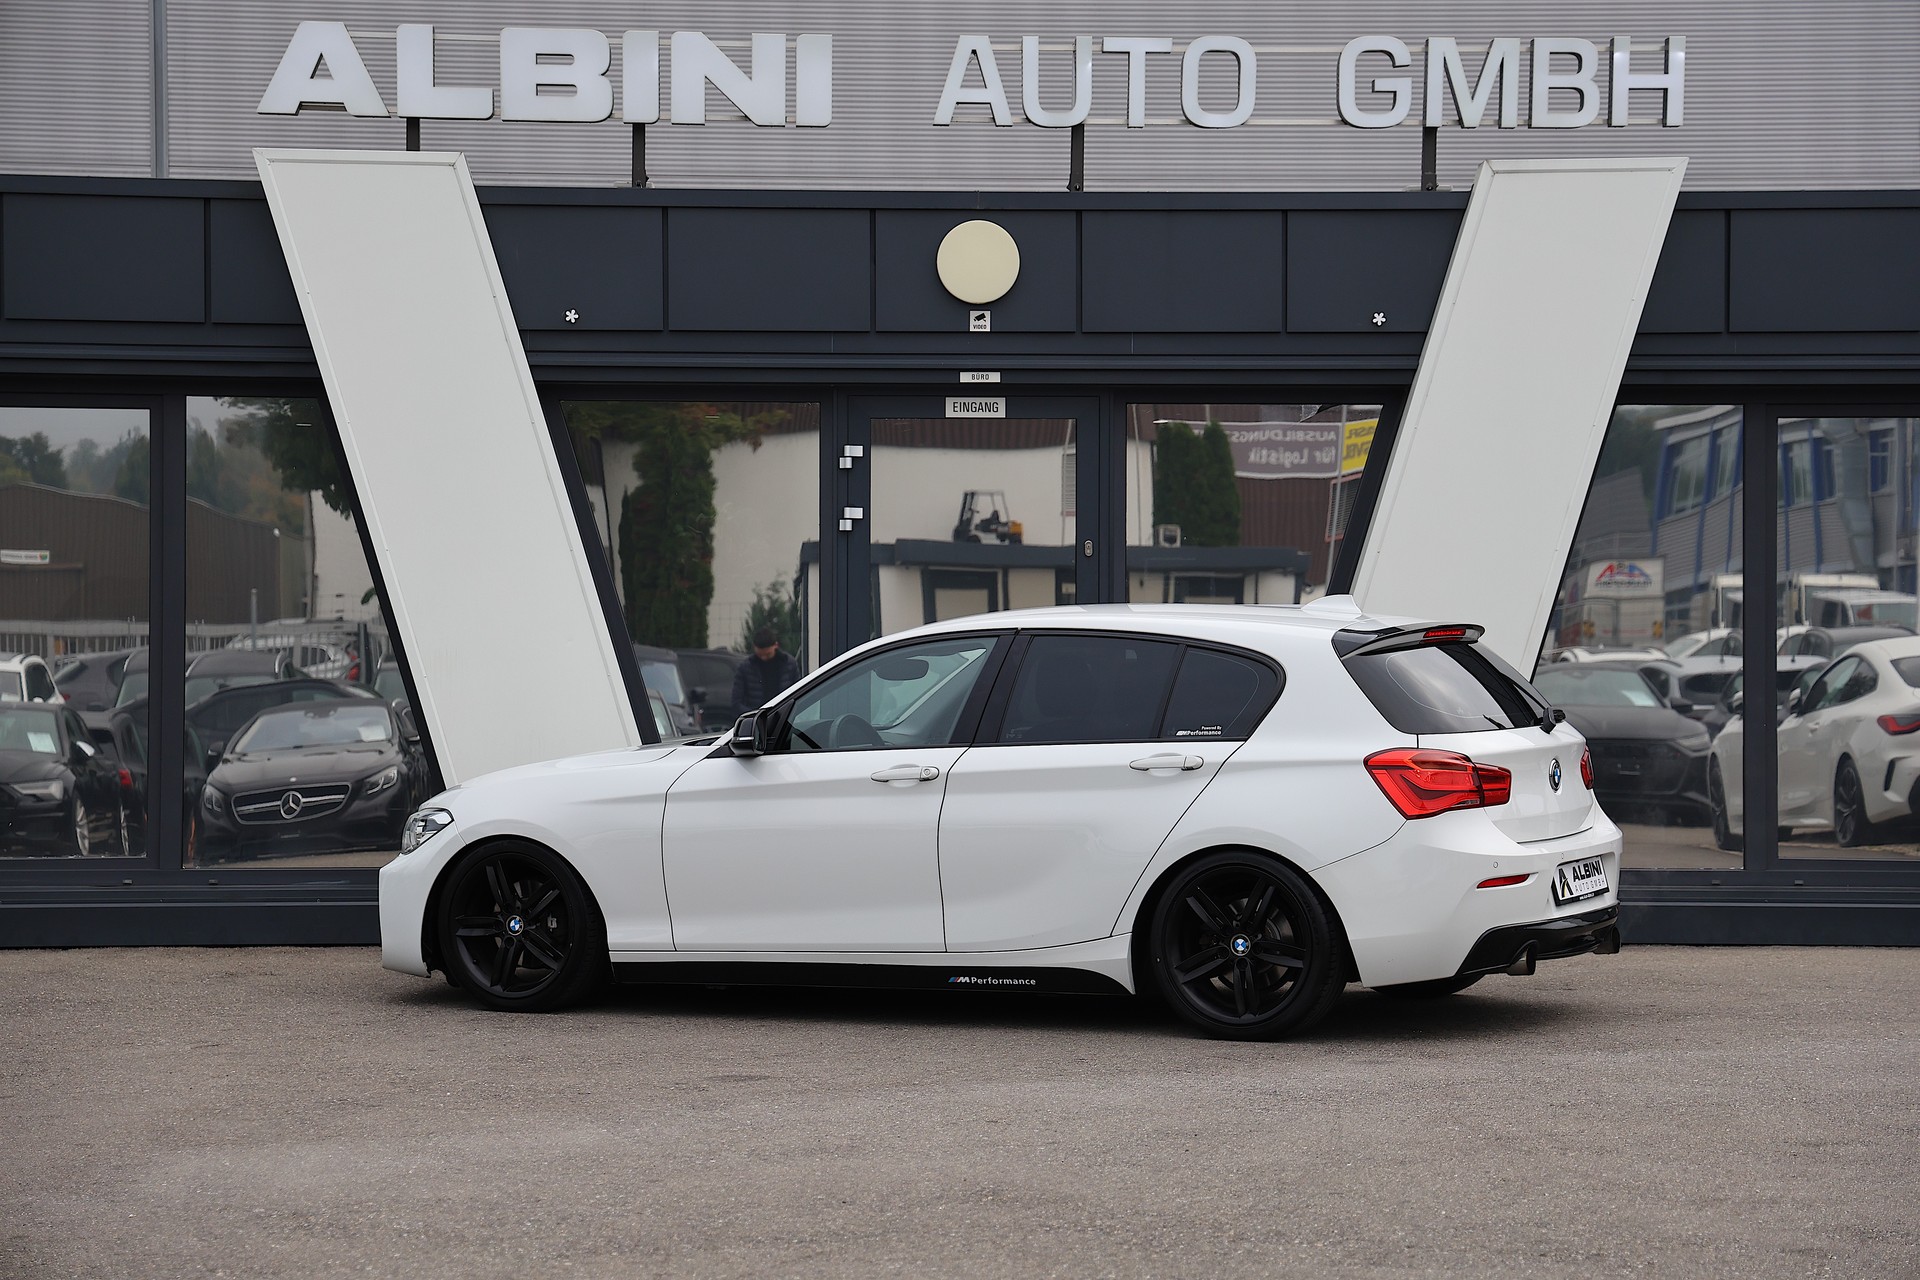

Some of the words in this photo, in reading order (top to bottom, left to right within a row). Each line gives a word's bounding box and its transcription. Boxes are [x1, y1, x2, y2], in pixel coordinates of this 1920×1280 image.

[257, 21, 833, 127] ALBINI
[933, 35, 1257, 129] AUTO
[1337, 35, 1687, 129] GMBH
[971, 373, 990, 381] BÜRO
[952, 401, 999, 413] EINGANG
[1572, 860, 1602, 882] ALBINI
[1574, 881, 1590, 892] AUTO
[970, 976, 1036, 985] Performance
